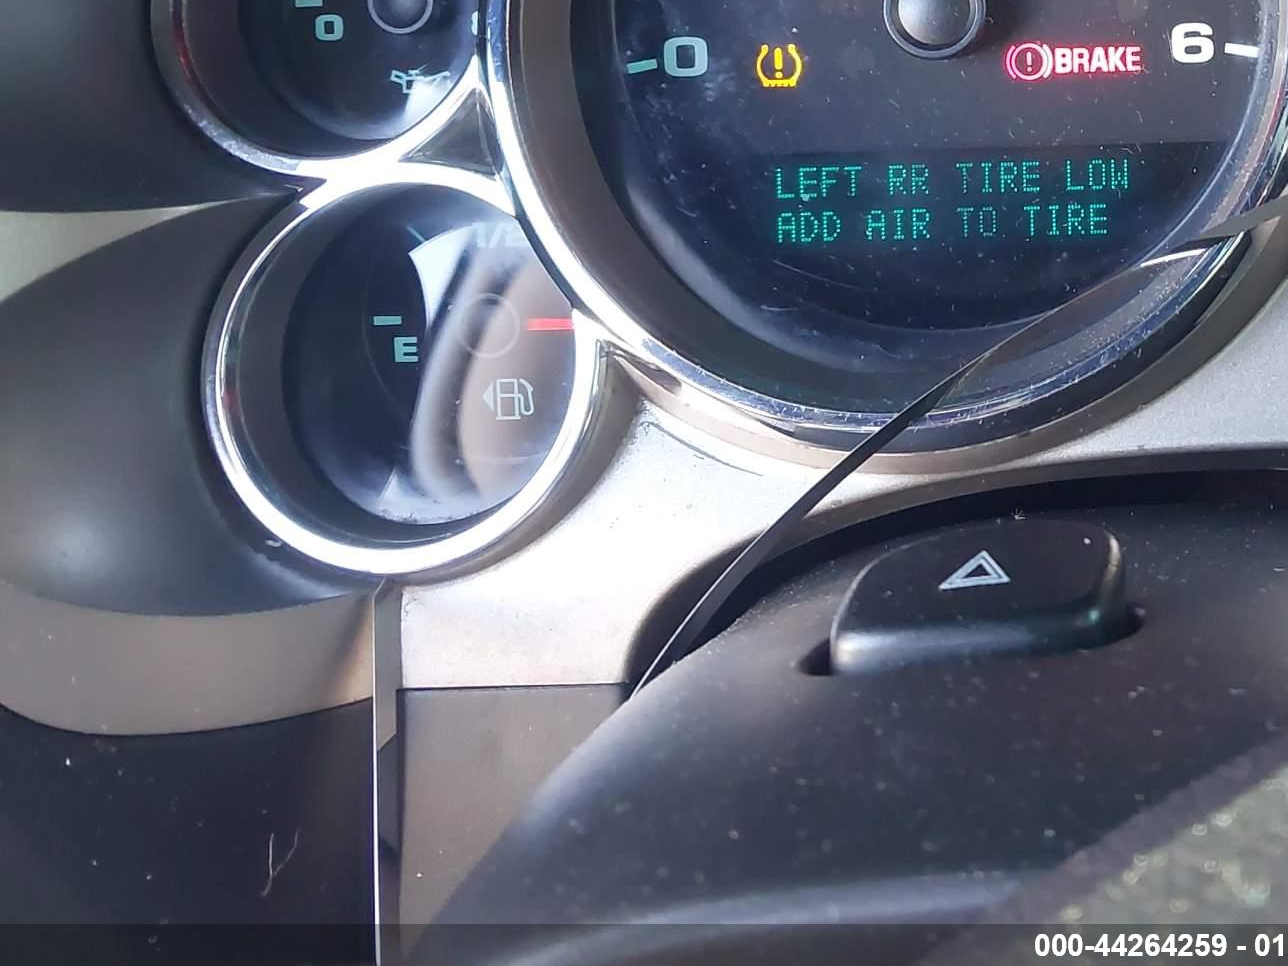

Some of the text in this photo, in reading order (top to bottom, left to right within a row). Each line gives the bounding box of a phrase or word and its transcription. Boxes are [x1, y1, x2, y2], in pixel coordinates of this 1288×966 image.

[315, 14, 344, 41] 0
[1170, 23, 1214, 63] 6
[663, 36, 708, 78] 0
[1053, 45, 1143, 76] BRAKE
[775, 158, 1130, 199] LEFT RR TIRE LOW
[775, 203, 1107, 244] ADD AIR TO TIRE
[394, 337, 419, 363] E
